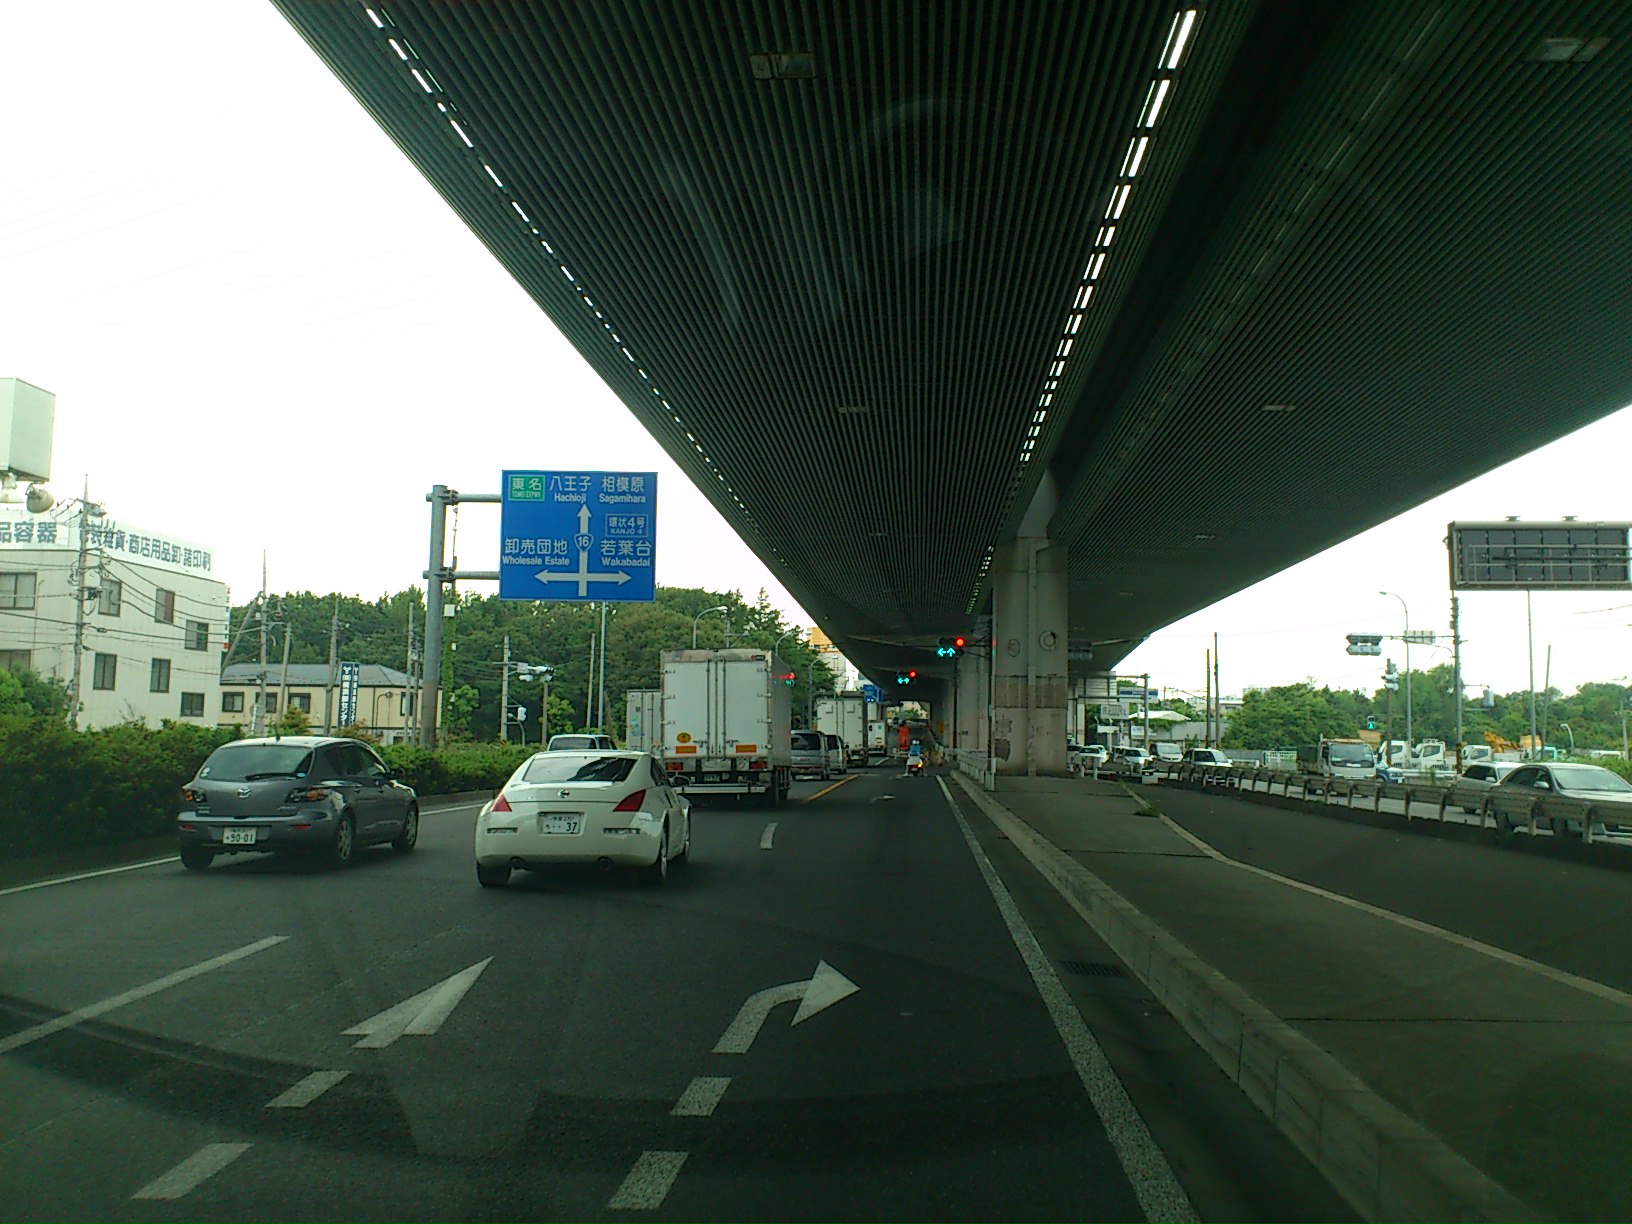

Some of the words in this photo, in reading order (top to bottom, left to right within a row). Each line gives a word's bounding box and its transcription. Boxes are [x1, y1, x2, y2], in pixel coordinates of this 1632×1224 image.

[511, 478, 542, 491] 東名
[549, 476, 592, 492] 八王子
[601, 476, 645, 493] 相模原
[553, 493, 587, 504] Hachioji
[599, 494, 646, 504] Sagamihara
[608, 517, 645, 528] 環状4号
[504, 538, 568, 555] 卸売団地
[577, 536, 589, 547] 16
[600, 540, 652, 556] 若葉台
[502, 556, 543, 565] Wholesale
[545, 557, 570, 566] Estate
[601, 557, 651, 567] Wakabadai
